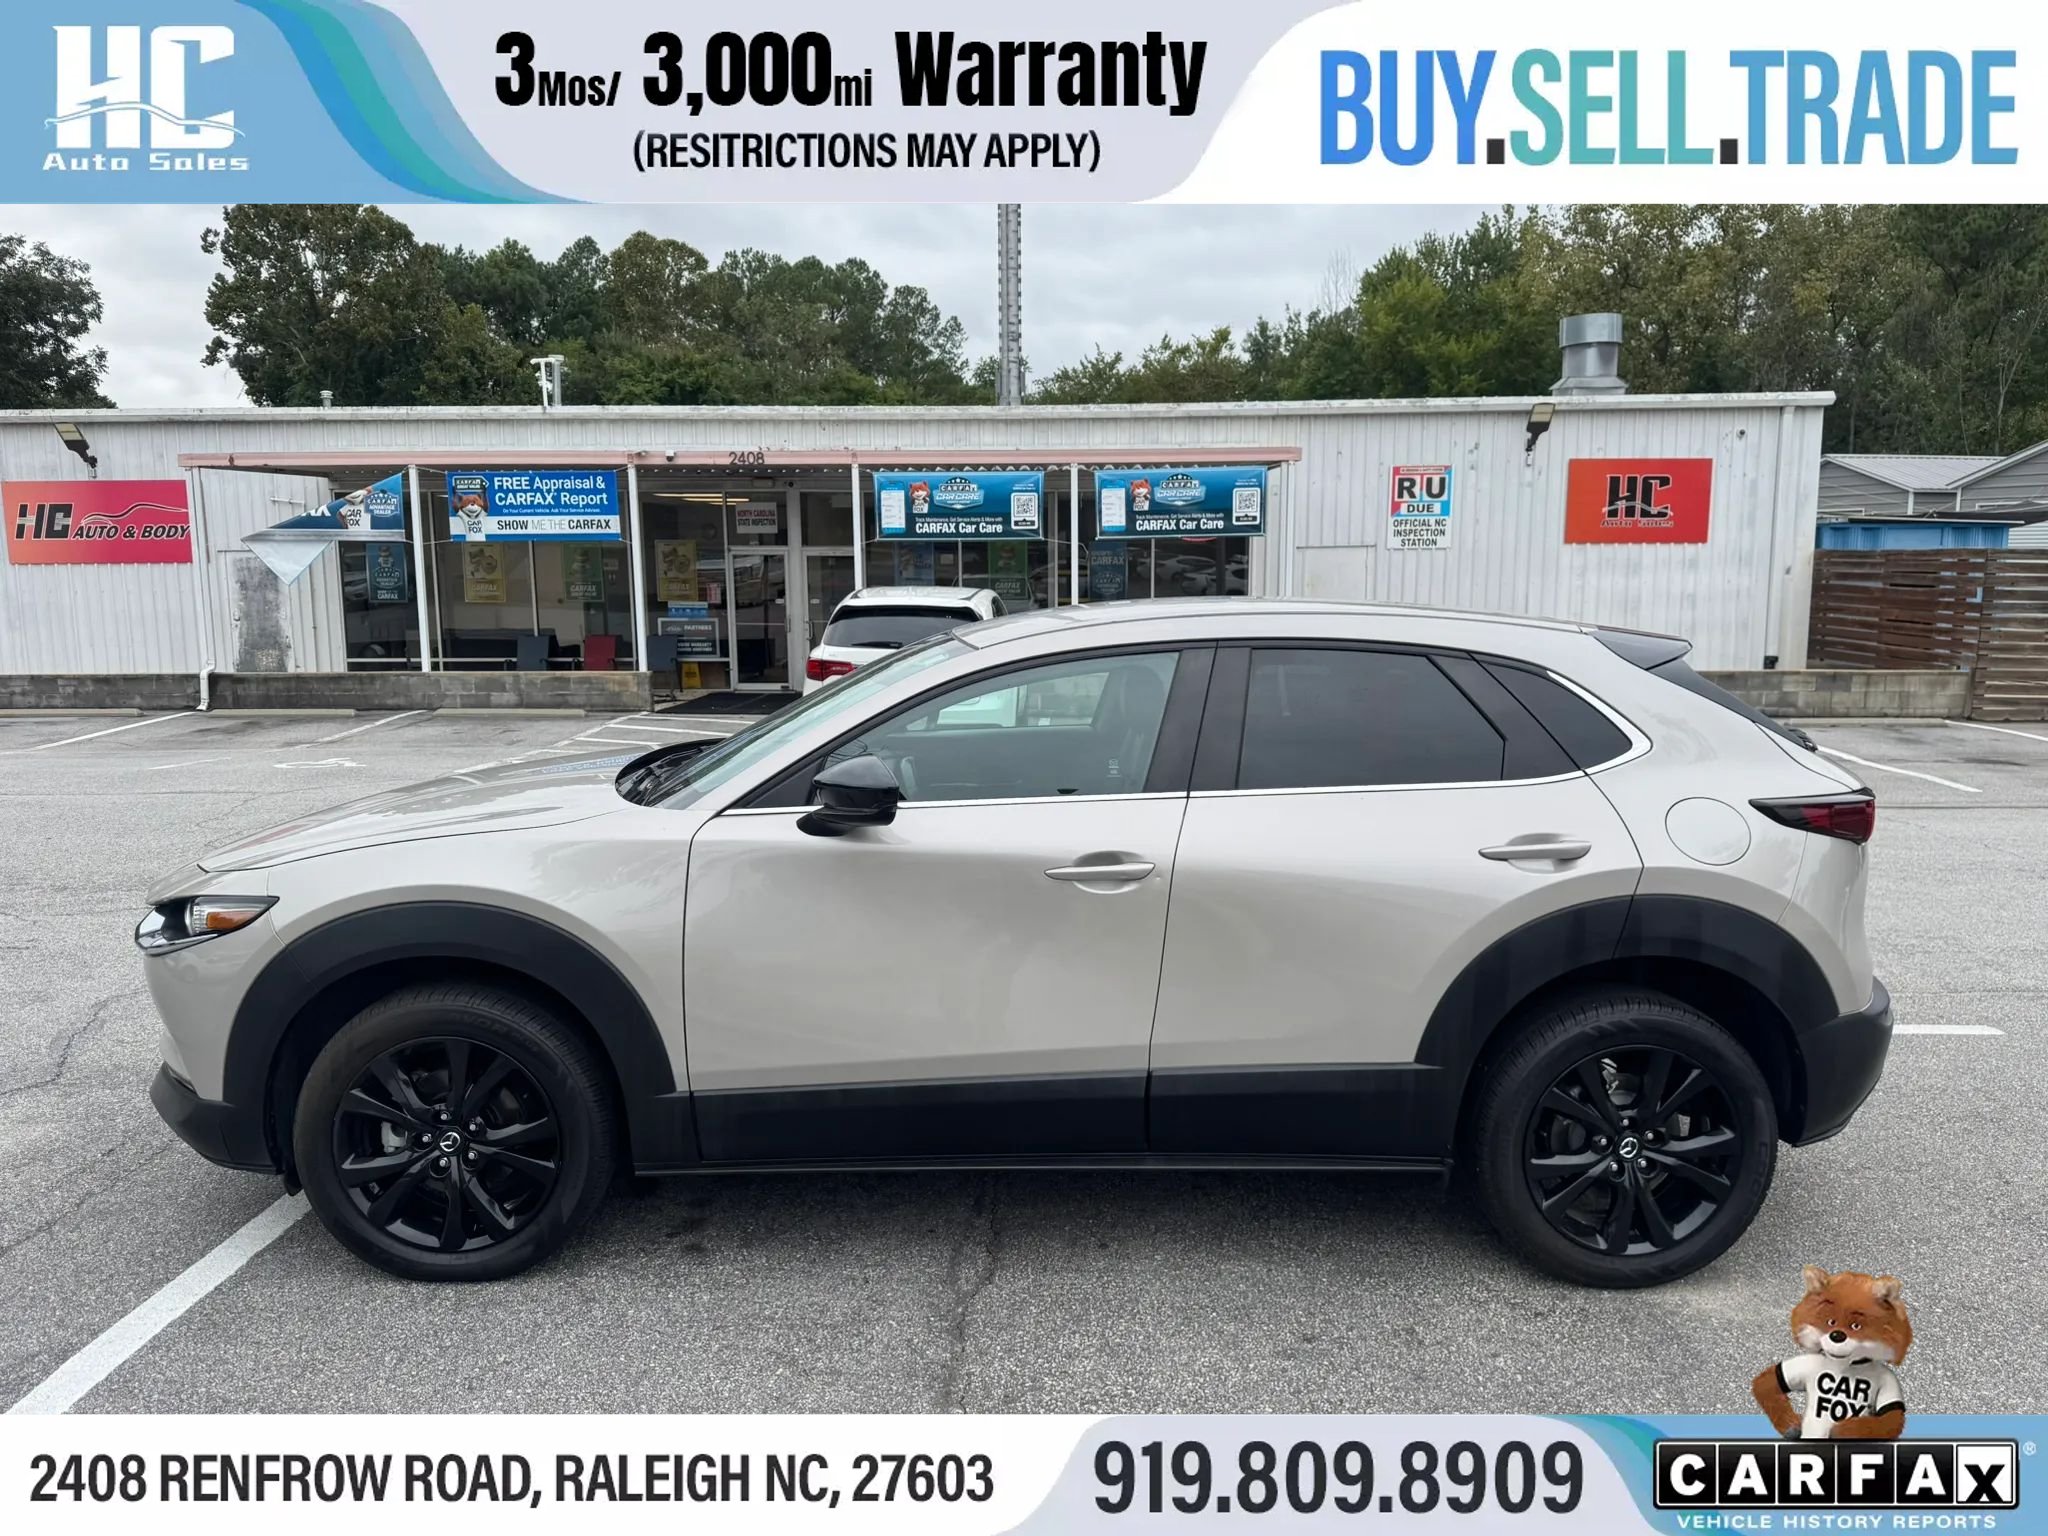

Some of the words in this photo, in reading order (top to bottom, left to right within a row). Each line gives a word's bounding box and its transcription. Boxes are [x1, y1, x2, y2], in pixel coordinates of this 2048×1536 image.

[728, 451, 765, 465] 2408
[494, 477, 530, 490] FREE
[533, 476, 593, 493] Appraisal
[596, 477, 606, 489] &
[561, 493, 608, 508] Report
[1606, 475, 1672, 520] HC
[1407, 504, 1434, 513] DUE
[15, 503, 73, 540] HC
[73, 524, 119, 539] AUTO
[122, 524, 137, 539] &
[141, 524, 190, 539] BODY
[497, 520, 528, 531] SHOW
[532, 519, 547, 531] ME
[548, 519, 566, 530] THE
[568, 519, 611, 530] CARFAX
[1136, 519, 1177, 531] CARFAX
[1180, 519, 1197, 530] Car
[1200, 518, 1224, 529] Care
[1393, 519, 1432, 527] OFFICIAL
[1435, 519, 1447, 527] NC
[915, 523, 956, 534] CARFAX
[959, 522, 977, 533] Car
[979, 522, 1003, 533] Care
[1393, 528, 1446, 537] INSPECTION
[1400, 538, 1438, 547] STATION
